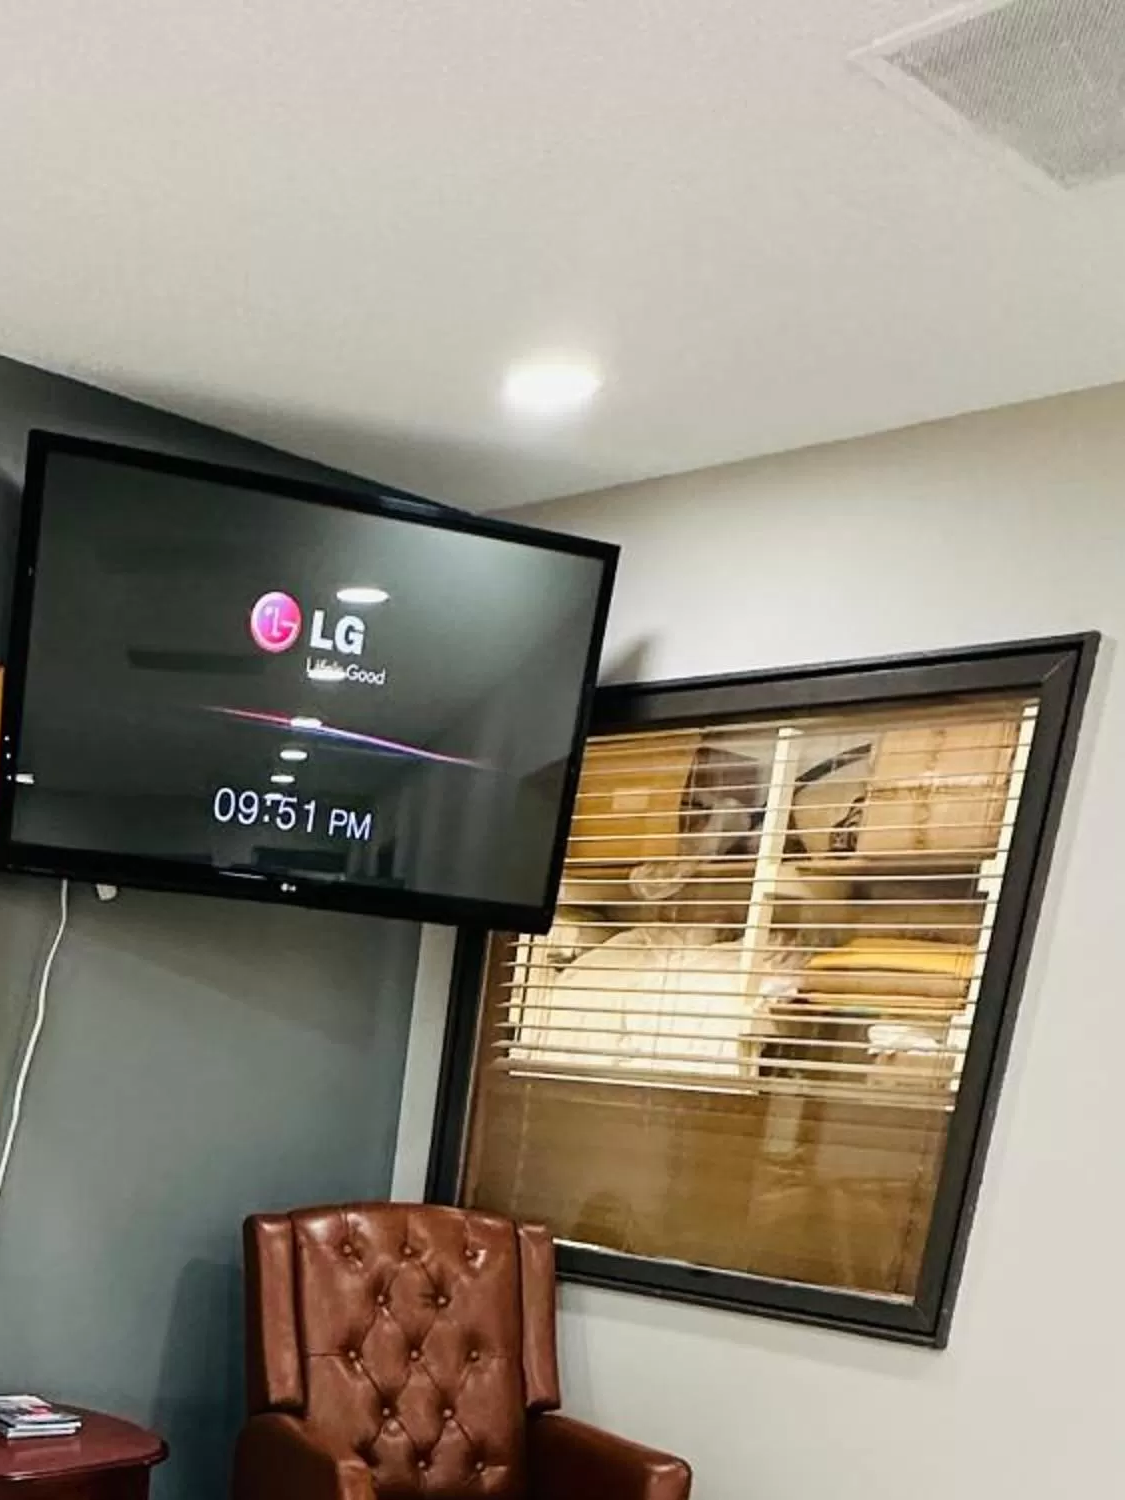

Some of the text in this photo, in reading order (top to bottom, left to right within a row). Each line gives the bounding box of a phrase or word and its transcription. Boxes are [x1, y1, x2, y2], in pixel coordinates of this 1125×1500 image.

[310, 609, 365, 655] LG
[346, 663, 386, 685] Good
[214, 787, 372, 840] 09:51 PM
